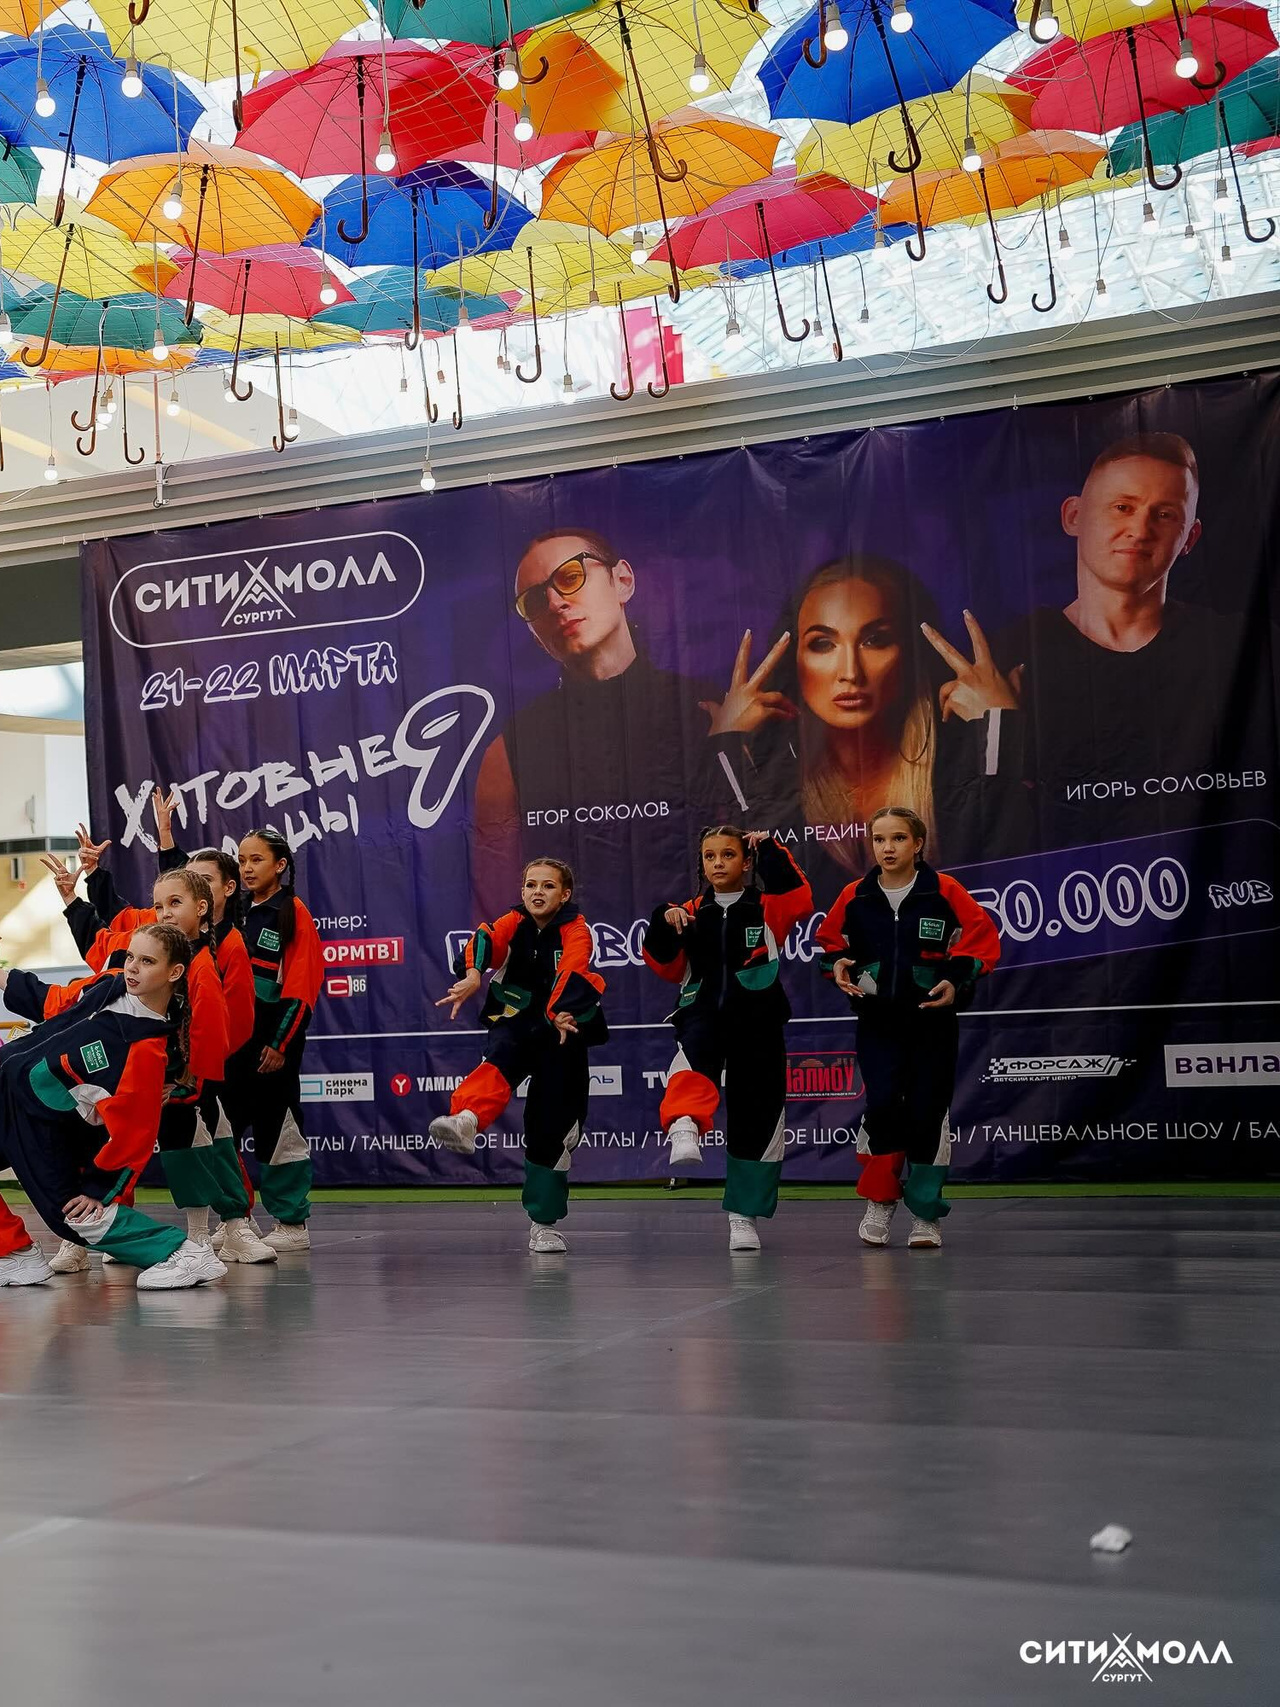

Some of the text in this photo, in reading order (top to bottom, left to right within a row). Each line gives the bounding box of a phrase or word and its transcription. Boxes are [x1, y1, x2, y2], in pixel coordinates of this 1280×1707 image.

[233, 608, 283, 626] СУРГУТ
[140, 641, 398, 710] 21-22 МАРТА
[1066, 770, 1267, 801] ИГОРЬ СОЛОВЬЕВ
[527, 801, 670, 826] ЕГОР СОКОЛОВ
[804, 822, 868, 842] РЕДИН
[966, 857, 1274, 942] 50.000 RUB
[312, 914, 368, 932] тнер:
[1009, 1058, 1104, 1071] ФОРСАЖ
[325, 1078, 368, 1088] синема
[325, 1086, 355, 1098] парк
[577, 1131, 635, 1148] АТТЛЫ
[982, 1123, 1158, 1143] ТАНЦЕВАЛЬНОЕ
[1166, 1122, 1223, 1140] ШОУ
